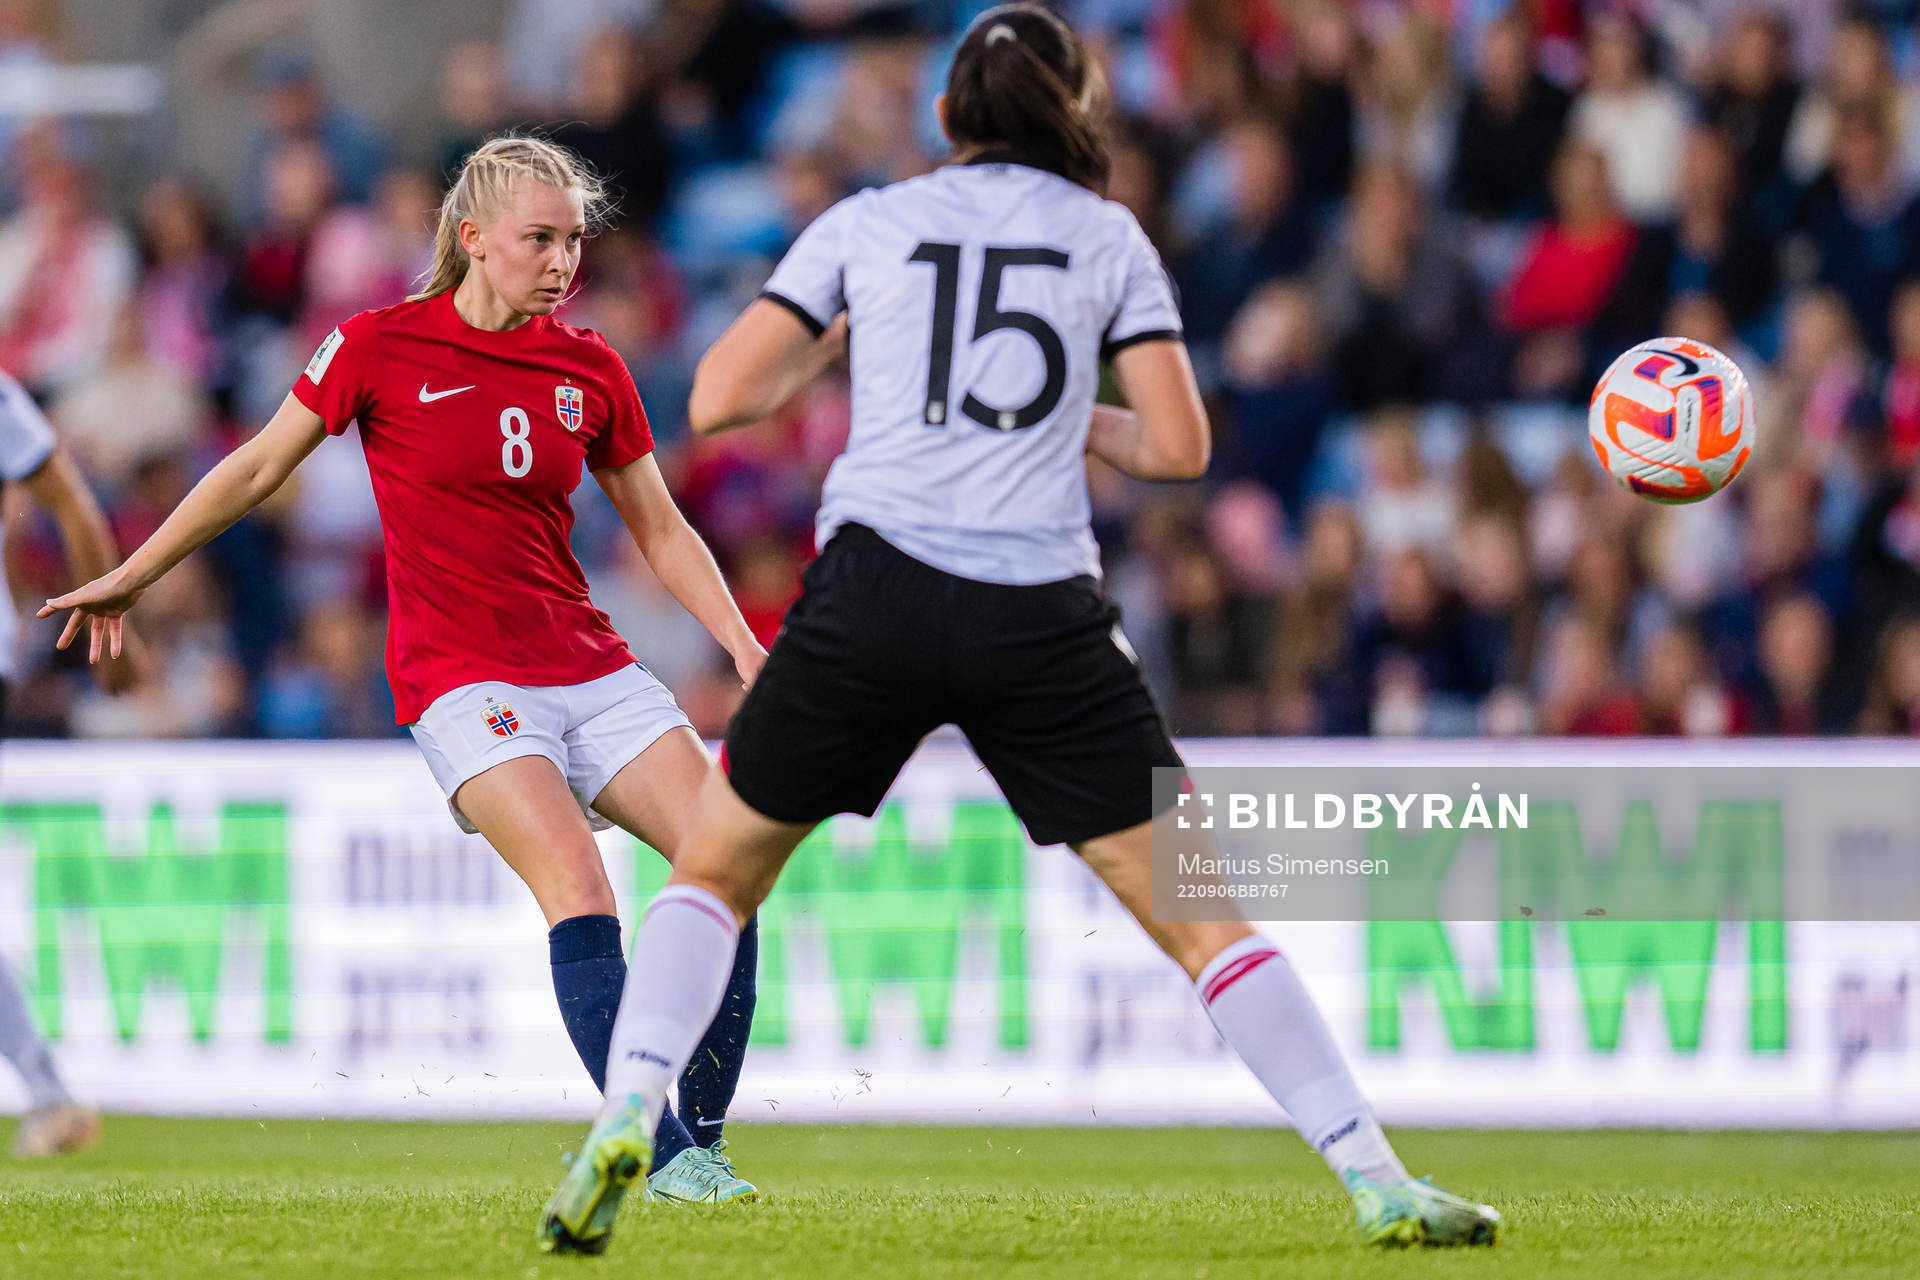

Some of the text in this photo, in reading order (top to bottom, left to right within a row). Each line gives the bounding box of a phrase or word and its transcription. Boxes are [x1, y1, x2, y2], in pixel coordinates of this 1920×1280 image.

[908, 242, 1070, 430] 15
[500, 407, 533, 478] 8
[1366, 800, 1789, 1053] KIWI
